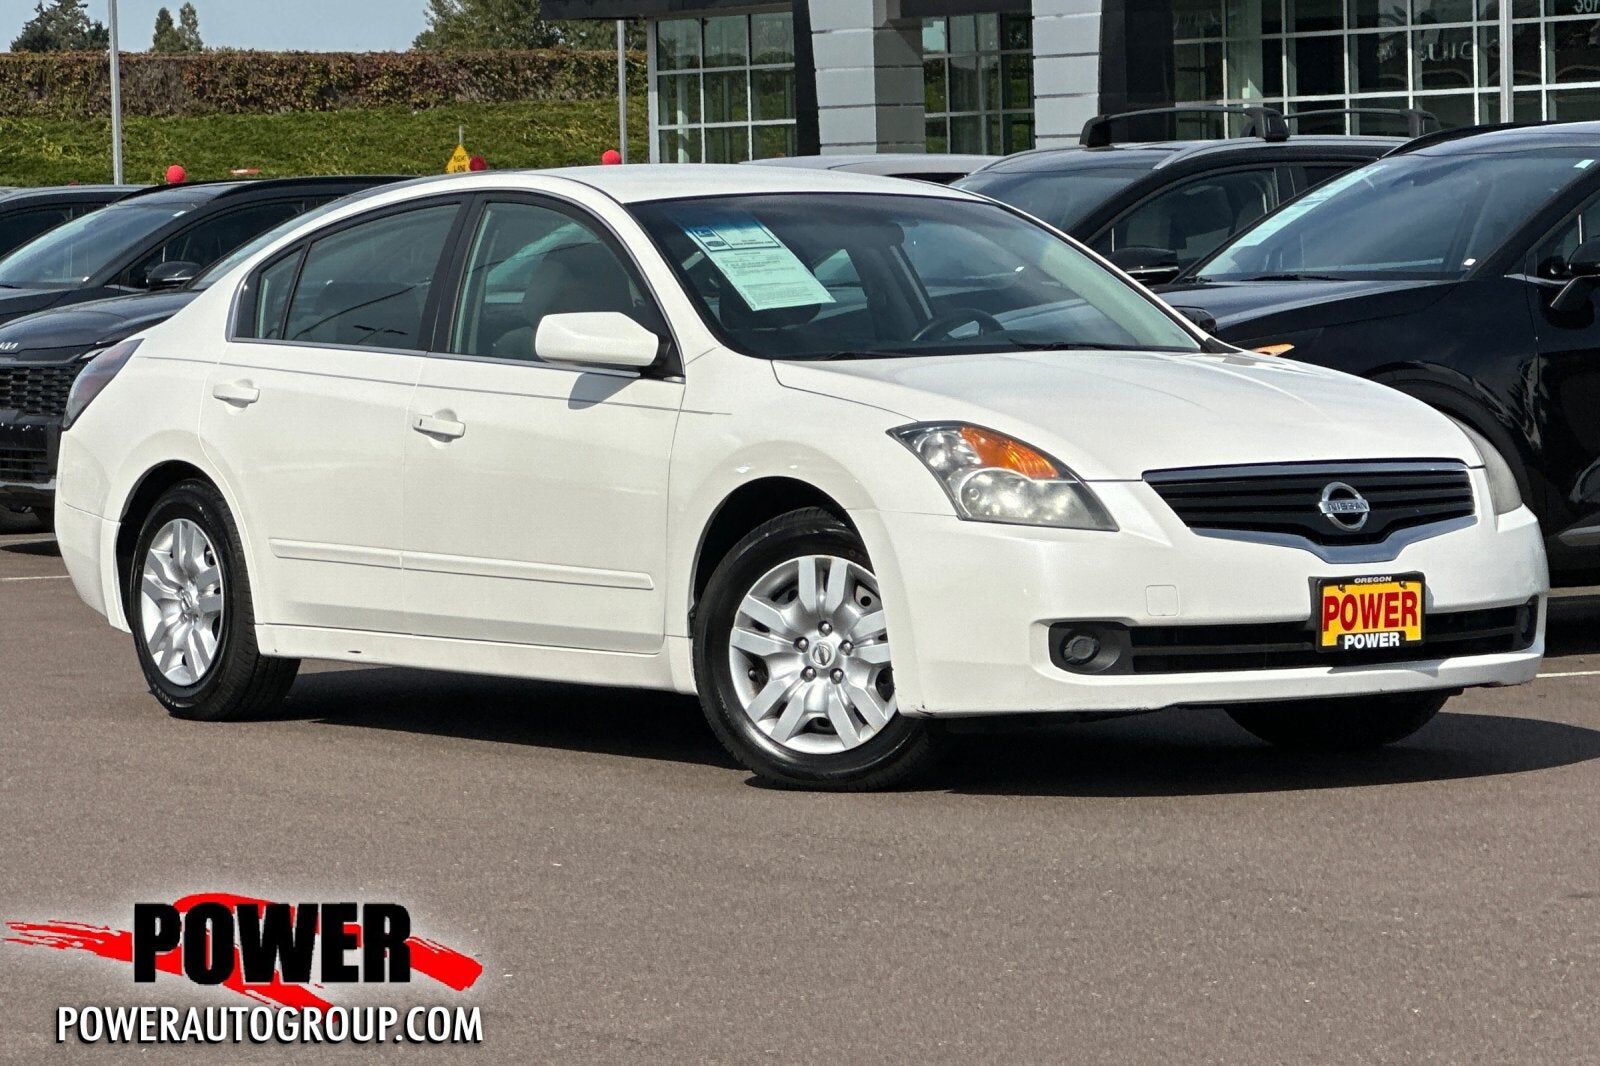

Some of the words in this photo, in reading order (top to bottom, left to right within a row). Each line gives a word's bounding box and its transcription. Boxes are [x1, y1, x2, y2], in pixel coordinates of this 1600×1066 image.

[1327, 501, 1368, 511] NISSAN
[1354, 576, 1392, 584] OREGON
[1322, 591, 1418, 632] POWER
[1344, 632, 1400, 650] POWER
